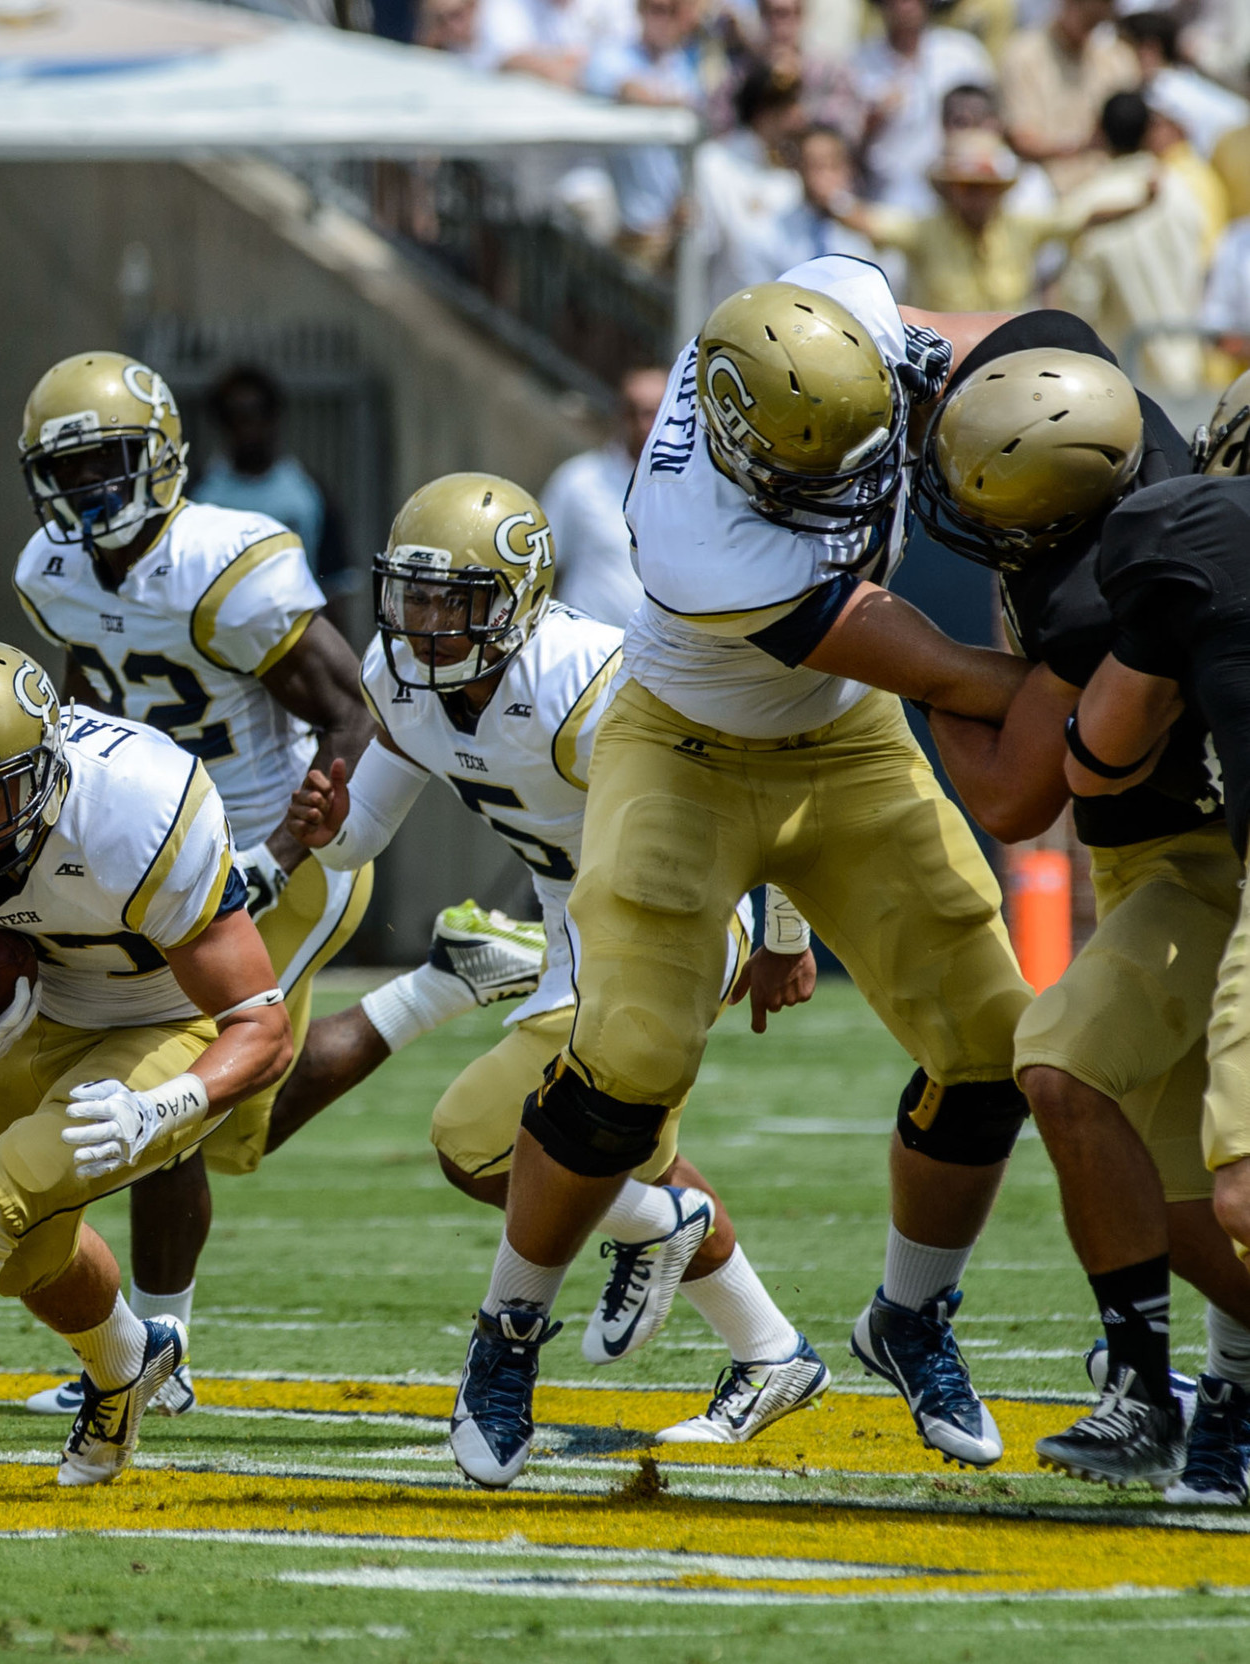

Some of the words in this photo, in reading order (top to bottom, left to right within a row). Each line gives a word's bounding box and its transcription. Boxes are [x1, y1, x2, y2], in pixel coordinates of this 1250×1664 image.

[409, 552, 435, 563] ACC
[504, 703, 532, 718] ACC
[455, 752, 489, 772] TECH
[55, 862, 85, 876] ACC
